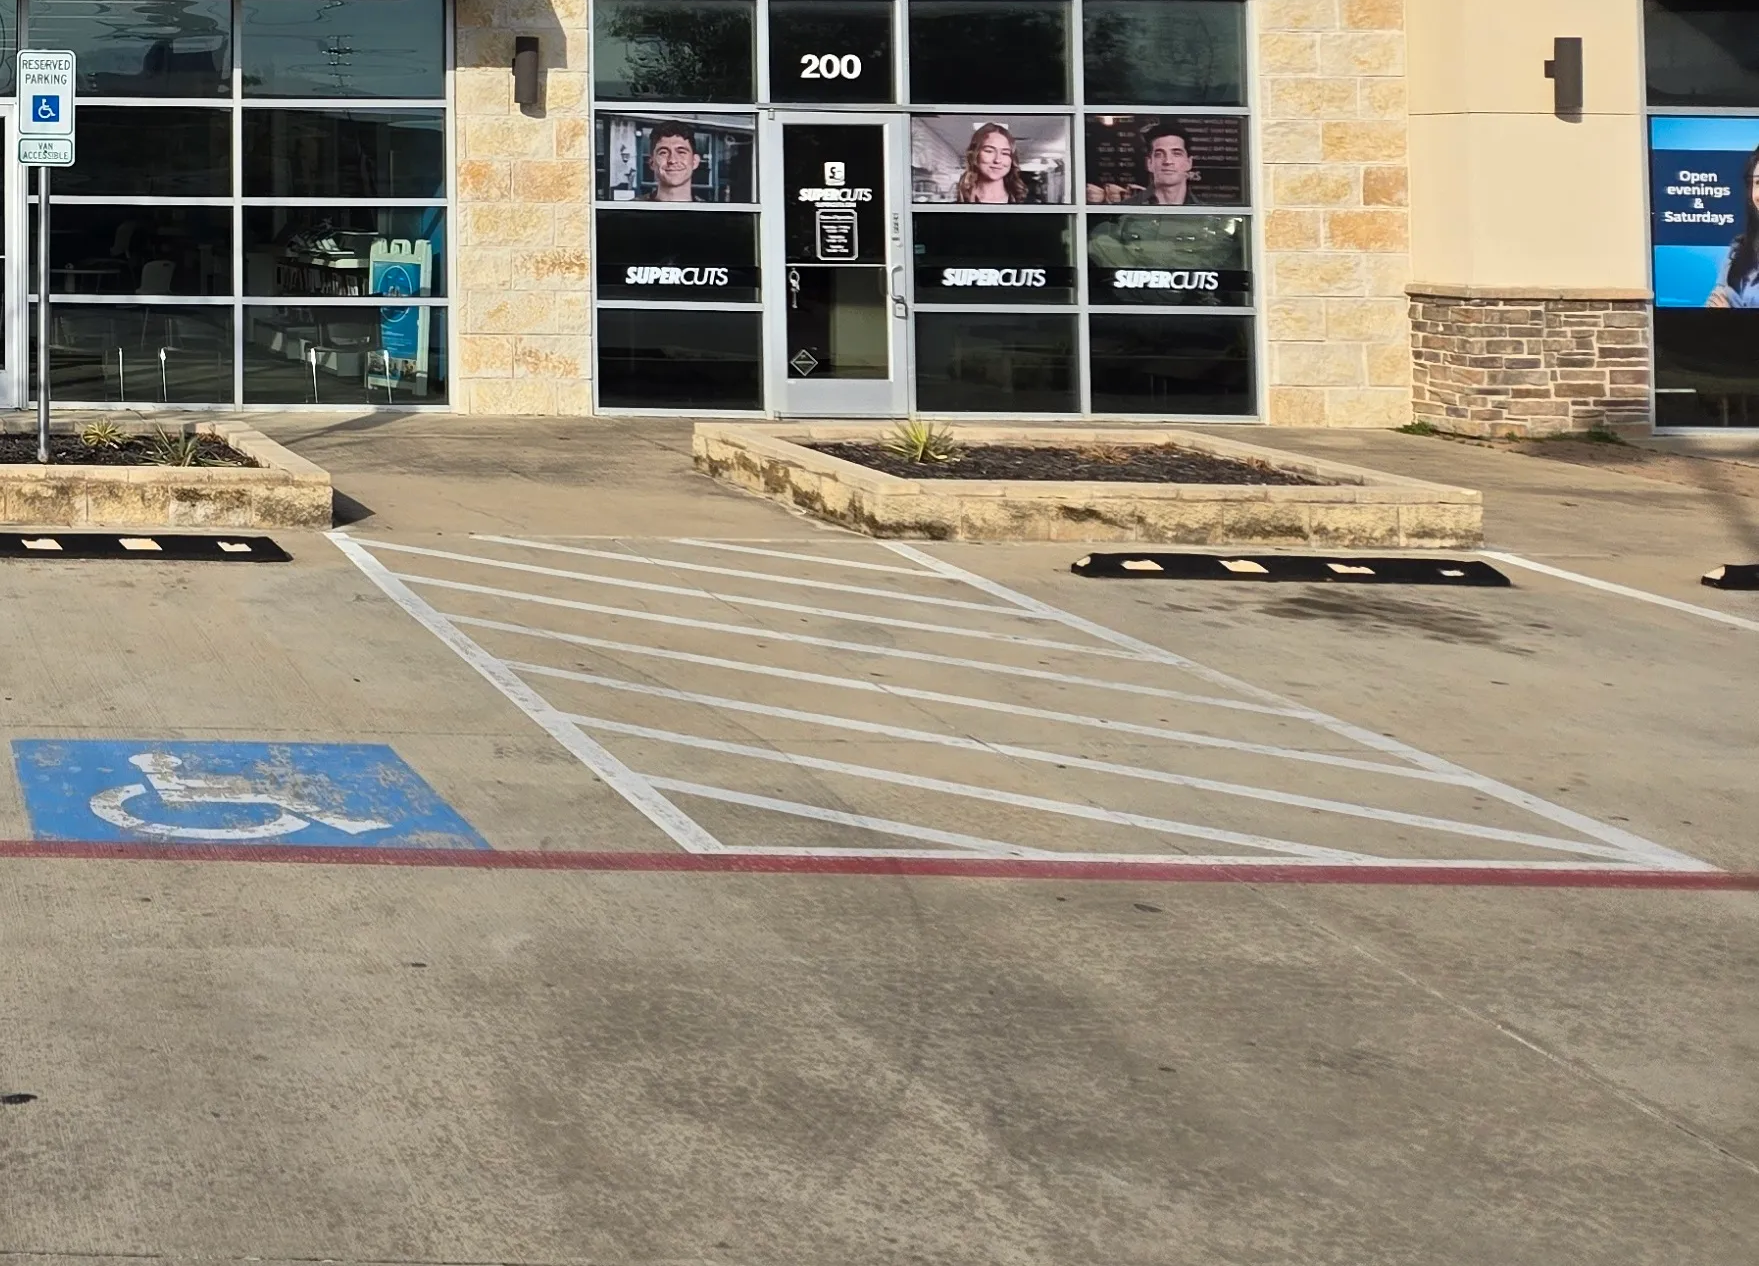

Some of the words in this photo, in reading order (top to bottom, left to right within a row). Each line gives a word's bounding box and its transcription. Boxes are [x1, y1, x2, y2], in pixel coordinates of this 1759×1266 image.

[21, 59, 71, 71] RESERVED
[800, 53, 862, 80] 200
[24, 73, 68, 85] PARKING
[37, 142, 54, 151] VAN
[22, 150, 69, 161] ACCESSIBLE
[1679, 170, 1718, 184] Open
[798, 187, 873, 202] SUPERCUTS
[1667, 183, 1731, 198] evenings
[1693, 197, 1705, 209] &
[1664, 211, 1734, 225] Saturdays
[625, 266, 729, 286] SUPERCUTS
[941, 267, 1046, 288] SUPERCUTS
[1113, 269, 1219, 291] SUPERCUTS
